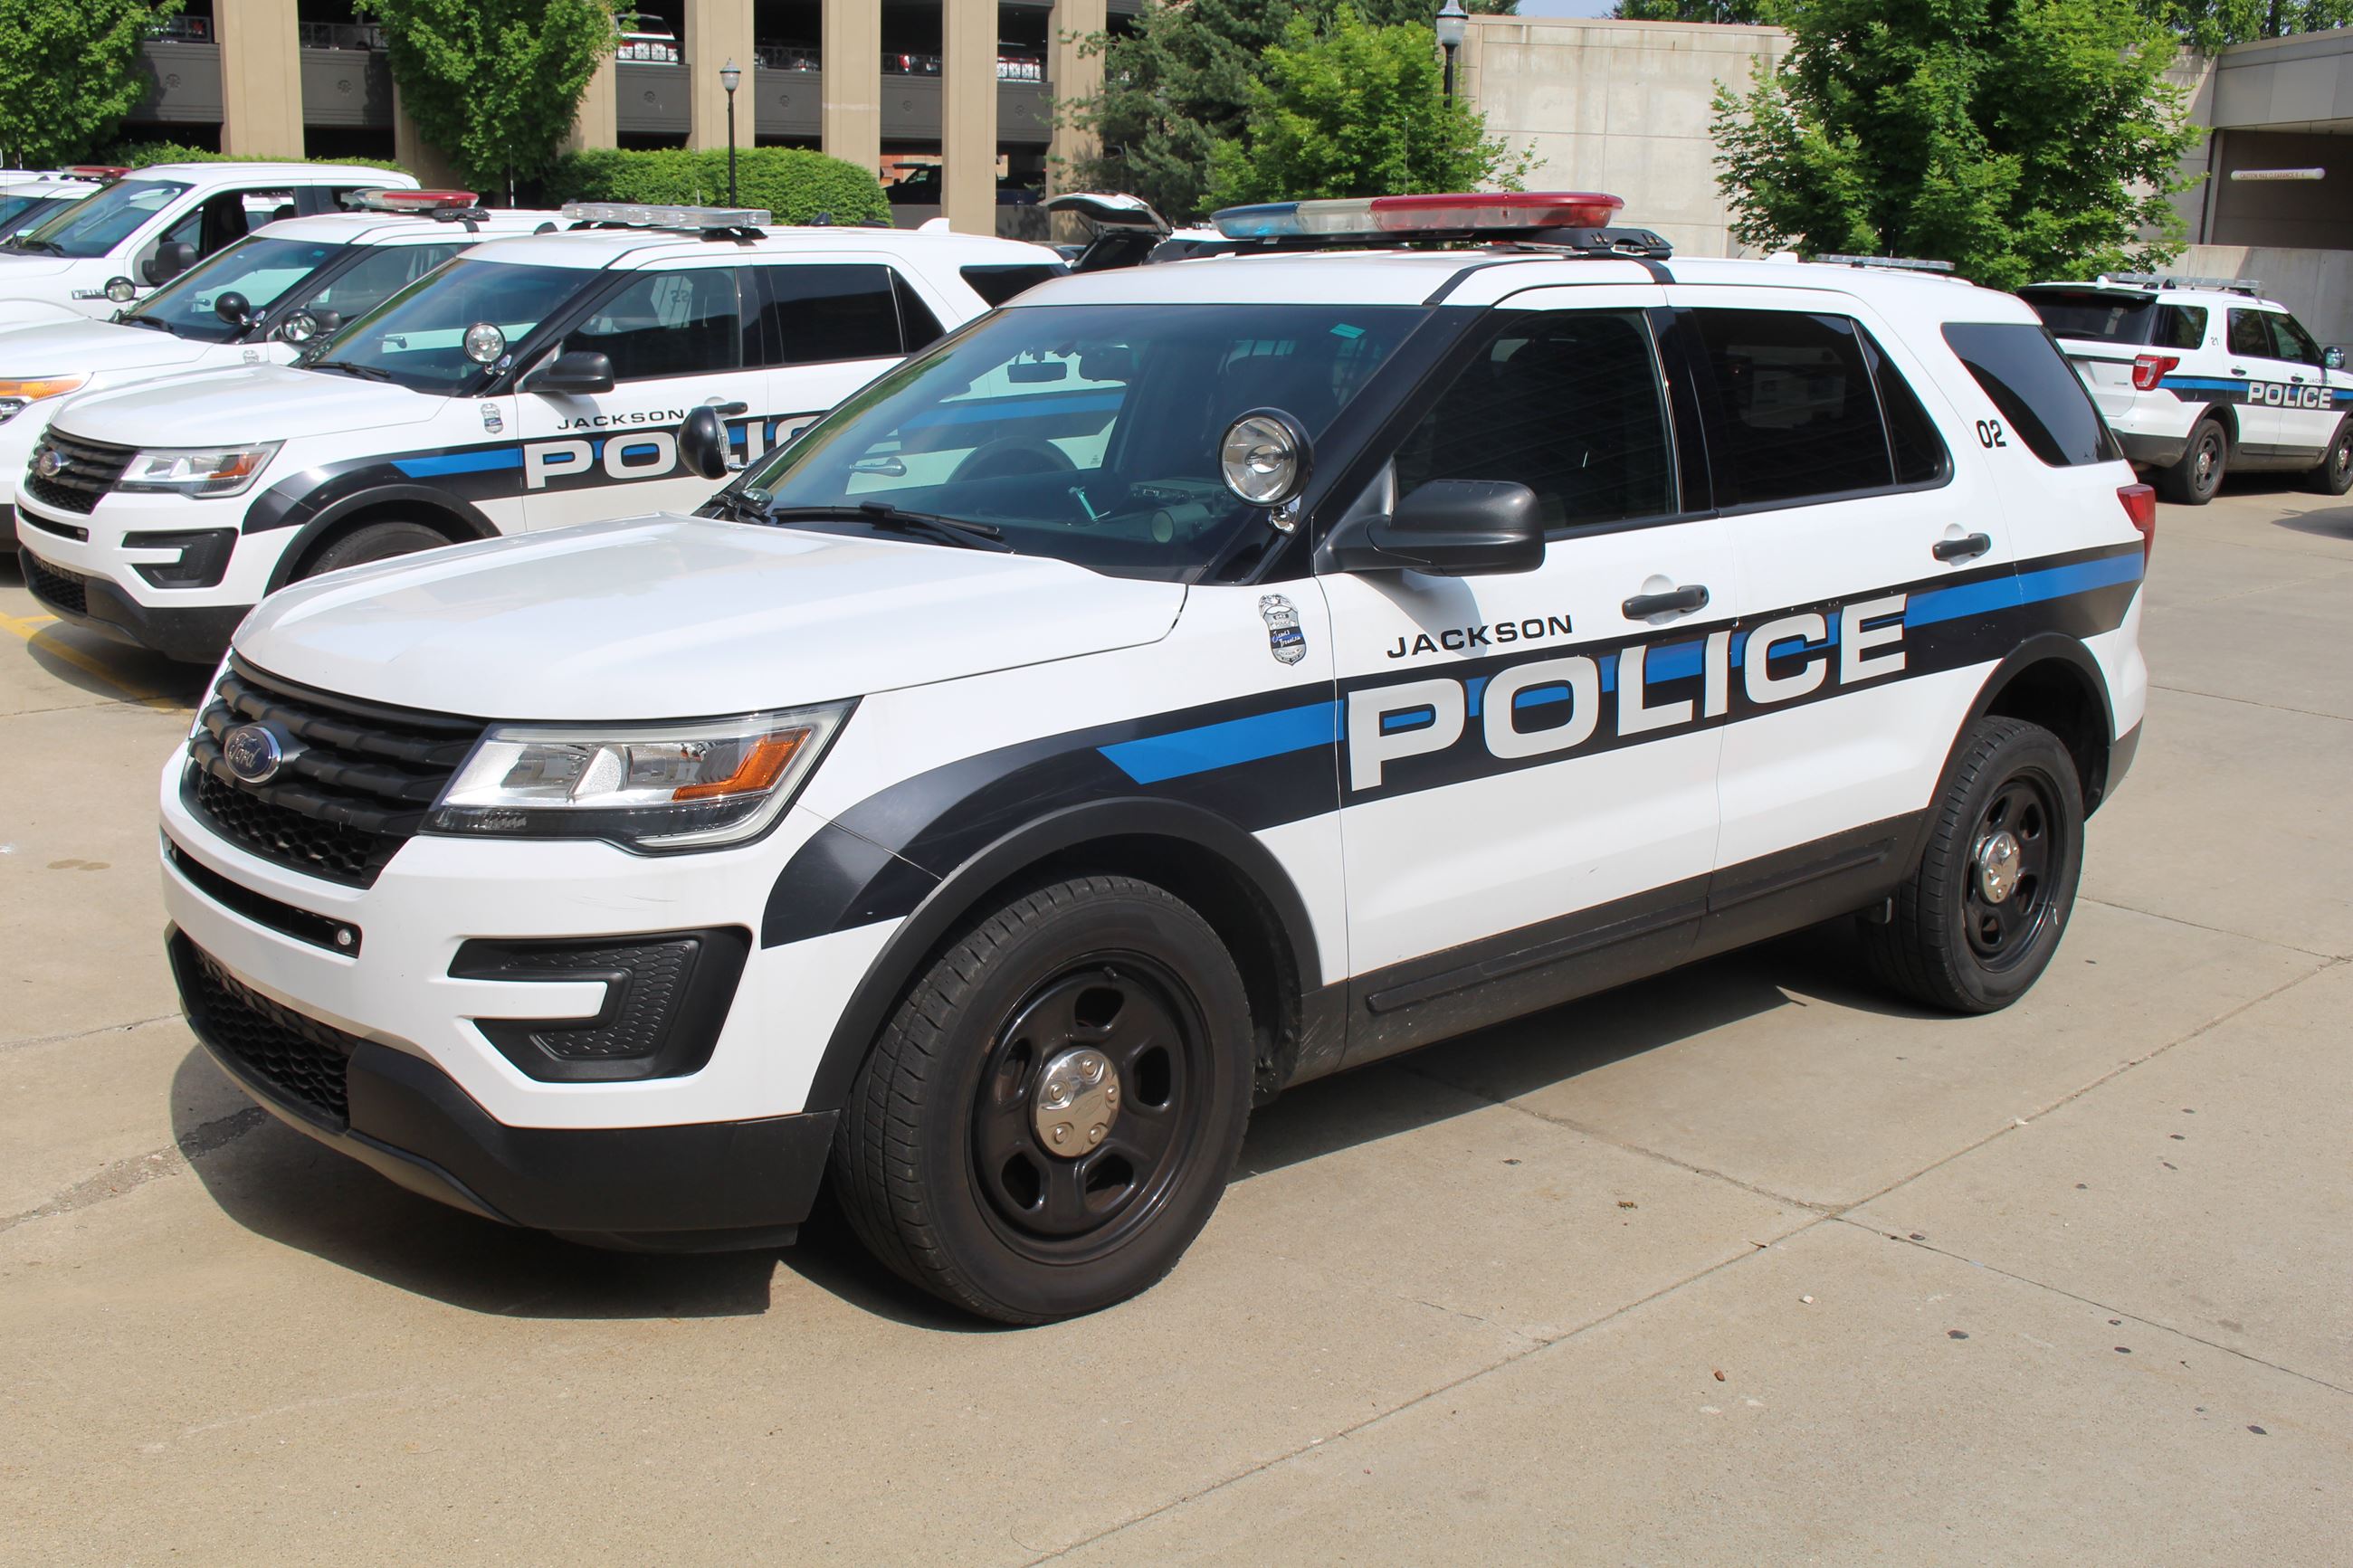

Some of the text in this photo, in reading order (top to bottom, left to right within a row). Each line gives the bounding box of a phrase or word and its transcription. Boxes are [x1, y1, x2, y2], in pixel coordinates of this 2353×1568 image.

[2247, 381, 2333, 409] POLICE
[557, 409, 684, 430] JACKSON
[1976, 419, 2006, 449] 02
[1386, 614, 1573, 659] JACKSON
[1348, 593, 1908, 792] POLICE
[228, 732, 261, 768] Ford
